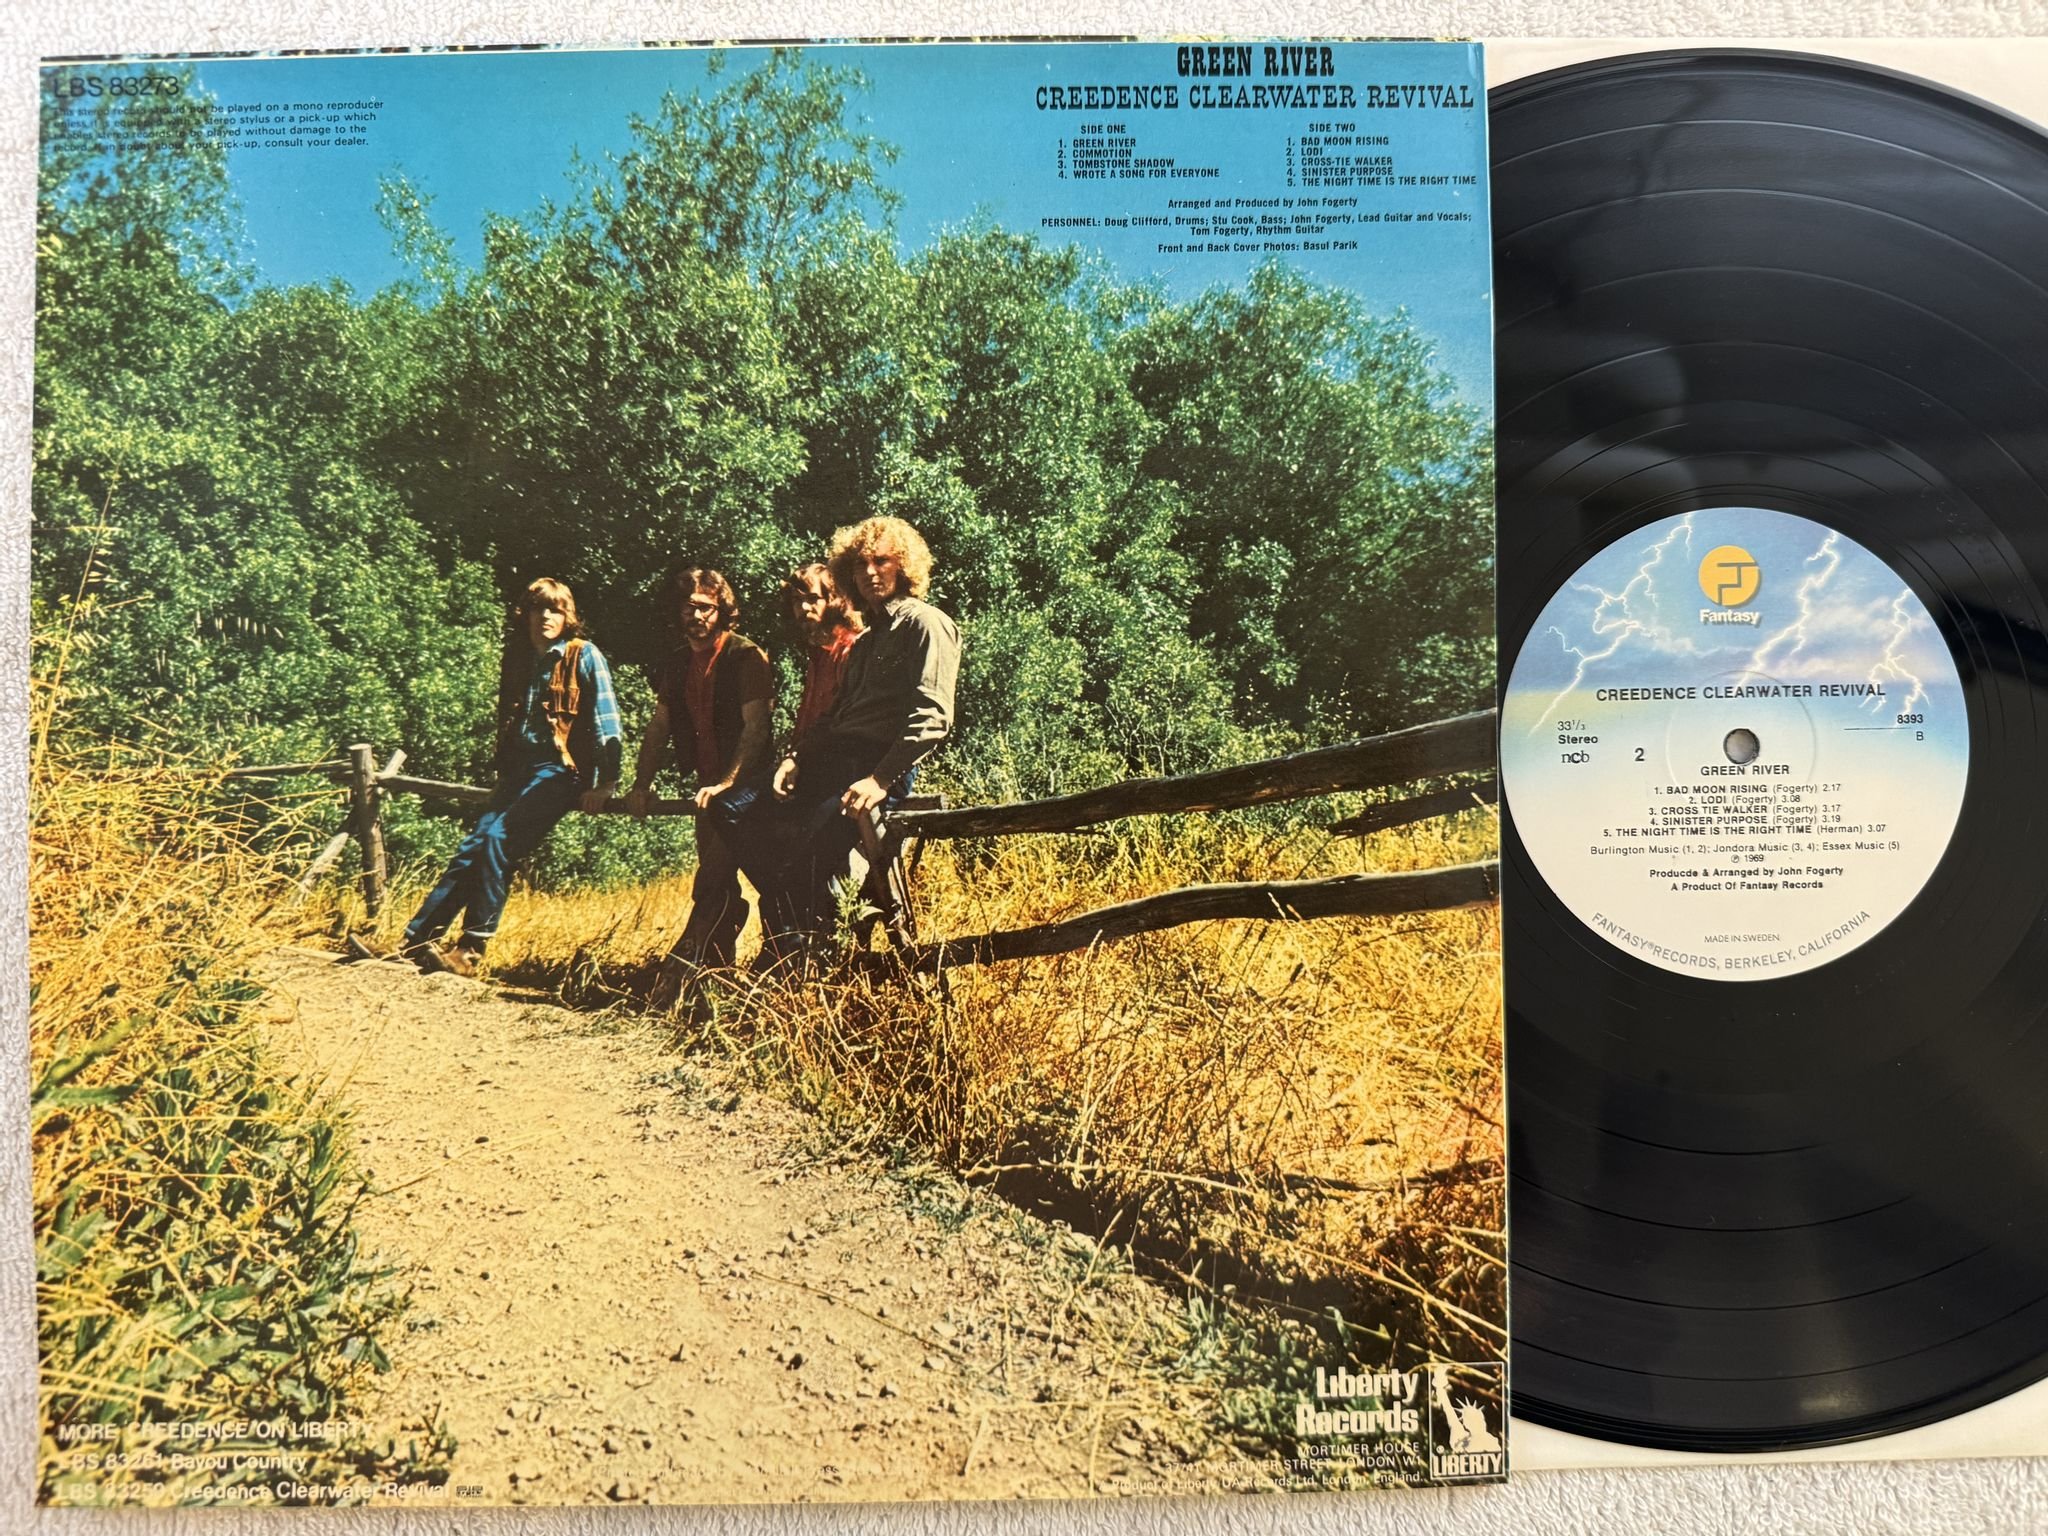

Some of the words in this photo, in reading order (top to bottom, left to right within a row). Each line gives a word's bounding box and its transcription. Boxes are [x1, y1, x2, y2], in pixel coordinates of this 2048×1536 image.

[1176, 46, 1251, 77] GREEN
[1263, 46, 1334, 76] RIVER
[54, 76, 103, 98] LBS
[110, 76, 180, 96] 83273
[1035, 84, 1179, 110] CREEDENCE
[1188, 84, 1356, 109] CLEARWATER
[1366, 83, 1474, 108] REVIVAL
[226, 102, 262, 114] played
[292, 103, 323, 111] mono
[326, 100, 384, 112] reproducer
[1080, 124, 1103, 134] SIDE
[1106, 124, 1126, 134] ONE
[1308, 122, 1332, 132] SIDE
[1334, 122, 1355, 132] TWO
[1058, 139, 1067, 148] 1.
[1072, 138, 1104, 148] GREEN
[1107, 138, 1136, 148] RIVER
[1286, 136, 1295, 146] 1.
[1300, 136, 1320, 146] BAD
[1323, 136, 1352, 146] MOON
[1355, 136, 1389, 145] RISING
[1057, 149, 1066, 158] 2.
[1072, 148, 1132, 158] COMMOTION
[1285, 147, 1295, 156] 2.
[1300, 146, 1323, 156] LODI
[1057, 159, 1067, 168] 3.
[1073, 158, 1131, 168] TOMBSTONE
[1133, 158, 1174, 168] SHADOW
[1286, 156, 1295, 166] 3.
[1300, 156, 1351, 166] CROSS-TIE
[1354, 156, 1392, 166] WALKER
[1057, 169, 1067, 179] 4.
[1072, 169, 1106, 179] WROTE
[1109, 169, 1116, 178] A
[1118, 168, 1145, 178] SONG
[1148, 168, 1166, 178] FOR
[1170, 168, 1219, 178] EVERYONE
[1286, 167, 1296, 176] 4.
[1301, 166, 1346, 176] SINISTER
[1349, 166, 1393, 176] PURPOSE
[1286, 177, 1296, 186] 5.
[1302, 176, 1320, 186] THE
[1323, 176, 1353, 186] NIGHT
[1356, 176, 1381, 186] TIME
[1384, 176, 1395, 185] IS
[1399, 176, 1416, 185] THE
[1419, 175, 1448, 185] RIGHT
[1453, 175, 1476, 185] TIME
[1167, 198, 1211, 210] Arranged
[1213, 198, 1231, 208] and
[1234, 197, 1280, 207] Produced
[1282, 197, 1294, 209] by
[1296, 197, 1318, 207] John
[1321, 197, 1358, 209] Fogerty
[1041, 216, 1101, 227] PERSONNEL:
[1104, 216, 1128, 228] Doug
[1131, 216, 1171, 228] Clifford,
[1174, 215, 1208, 227] Drums;
[1211, 215, 1227, 225] Stu
[1231, 214, 1257, 226] Cook,
[1260, 214, 1286, 226] Bass;
[1289, 214, 1311, 224] John
[1315, 213, 1354, 226] Fogerty,
[1357, 213, 1380, 223] Lead
[1383, 212, 1413, 222] Guitar
[1416, 212, 1433, 222] and
[1436, 212, 1471, 224] Vocals;
[1190, 226, 1210, 235] Tom
[1213, 225, 1253, 237] Fogerty,
[1255, 225, 1291, 237] Rhythm
[1295, 224, 1324, 234] Guitar
[1157, 242, 1183, 252] Front
[1186, 242, 1204, 252] and
[1206, 242, 1230, 252] Back
[1233, 241, 1260, 251] Cover
[1263, 241, 1299, 251] Photos:
[1332, 240, 1358, 250] Parik
[1699, 608, 1761, 626] Fantasy
[1595, 686, 1696, 701] CREEDENCE
[1702, 684, 1812, 699] CLEARWATER
[1818, 682, 1886, 697] REVIVAL
[1896, 713, 1924, 724] 8393
[1557, 733, 1598, 744] Stereo
[1915, 730, 1924, 741] B
[1560, 748, 1590, 764] ncb
[1634, 747, 1645, 762] 2
[1700, 766, 1745, 776] GREEN
[1751, 765, 1790, 775] RIVER
[1654, 785, 1662, 794] 1.
[1666, 785, 1689, 794] BAD
[1692, 784, 1726, 794] MOON
[1729, 784, 1767, 793] RISING
[1772, 783, 1817, 795] (Fogerty)
[1822, 782, 1841, 792] 2.17
[1688, 796, 1697, 804] 2.
[1700, 795, 1727, 804] LODI
[1731, 795, 1776, 805] (Fogerty)
[1781, 794, 1801, 803] 3.08
[1648, 806, 1657, 815] 3.
[1660, 806, 1699, 815] CROSS
[1702, 805, 1719, 814] TIE
[1722, 804, 1767, 814] WALKER
[1772, 803, 1817, 815] (Fogerty)
[1822, 803, 1841, 812] 3.17
[1649, 817, 1659, 826] 4.
[1662, 816, 1713, 826] SINISTER
[1716, 815, 1768, 825] PURPOSE
[1772, 814, 1817, 826] (Fogerty)
[1821, 813, 1841, 823] 3.19
[1602, 827, 1612, 837] 5.
[1615, 827, 1638, 837] THE
[1640, 826, 1676, 836] NIGHT
[1678, 826, 1706, 836] TIME
[1709, 826, 1720, 835] IS
[1723, 825, 1745, 835] THE
[1748, 825, 1782, 834] RIGHT
[1785, 824, 1812, 834] TIME
[1816, 823, 1862, 836] (Herman)
[1867, 823, 1886, 833] 3.07
[1701, 867, 1709, 876] &
[1712, 866, 1759, 878] Arranged
[1762, 866, 1774, 878] by
[1777, 866, 1802, 875] John
[1805, 865, 1843, 877] Fogerty
[1652, 946, 1720, 971] RECORDS,
[1724, 950, 1796, 970] BERKELEY,
[1799, 910, 1871, 956] CALIFORNIA
[1703, 934, 1729, 942] MADE
[1730, 934, 1741, 942] IN
[1742, 933, 1780, 942] SWEDEN
[1316, 1366, 1418, 1402] Liberty
[1296, 1401, 1418, 1436] Records
[58, 1423, 118, 1442] MORE
[256, 1422, 285, 1438] ON
[293, 1422, 373, 1438] LIBERTY
[1298, 1444, 1369, 1458] MORTIMER
[1374, 1442, 1420, 1454] HOUSE
[172, 1453, 228, 1473] Bayou
[233, 1453, 306, 1472] Country
[1432, 1453, 1502, 1476] LIBERTY
[171, 1482, 273, 1499] Creedence
[276, 1481, 378, 1498] Clearwater
[385, 1481, 450, 1498] Revival
